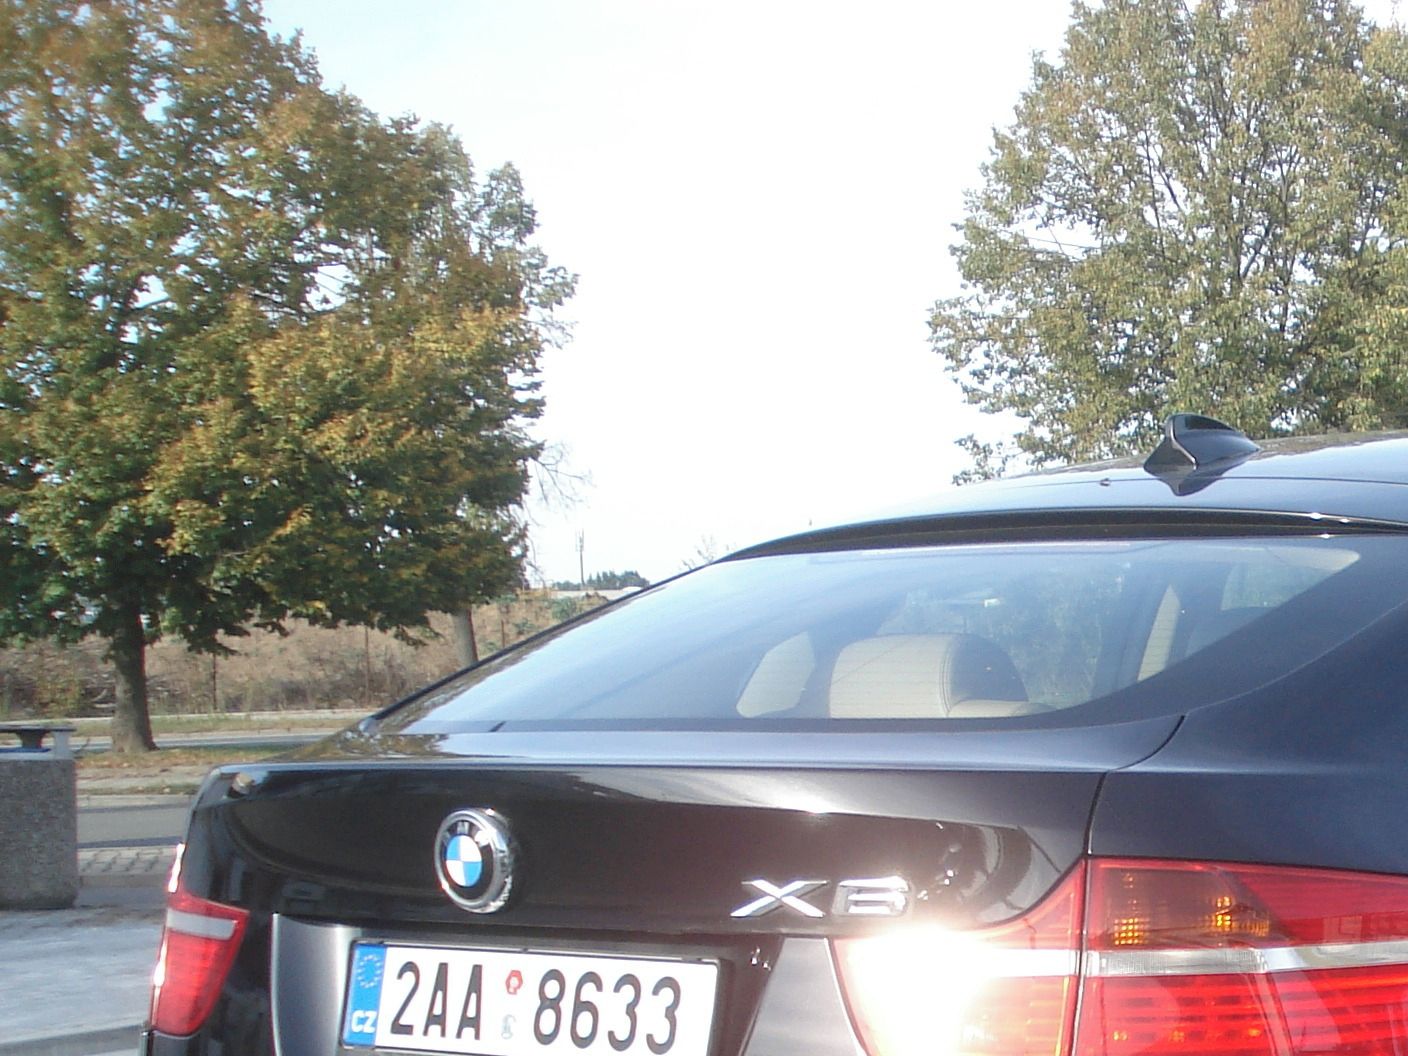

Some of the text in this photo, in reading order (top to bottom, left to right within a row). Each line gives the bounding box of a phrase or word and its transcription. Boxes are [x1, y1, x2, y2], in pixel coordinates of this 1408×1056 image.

[351, 1010, 377, 1033] CZ
[390, 961, 681, 1056] 2AA 8633
